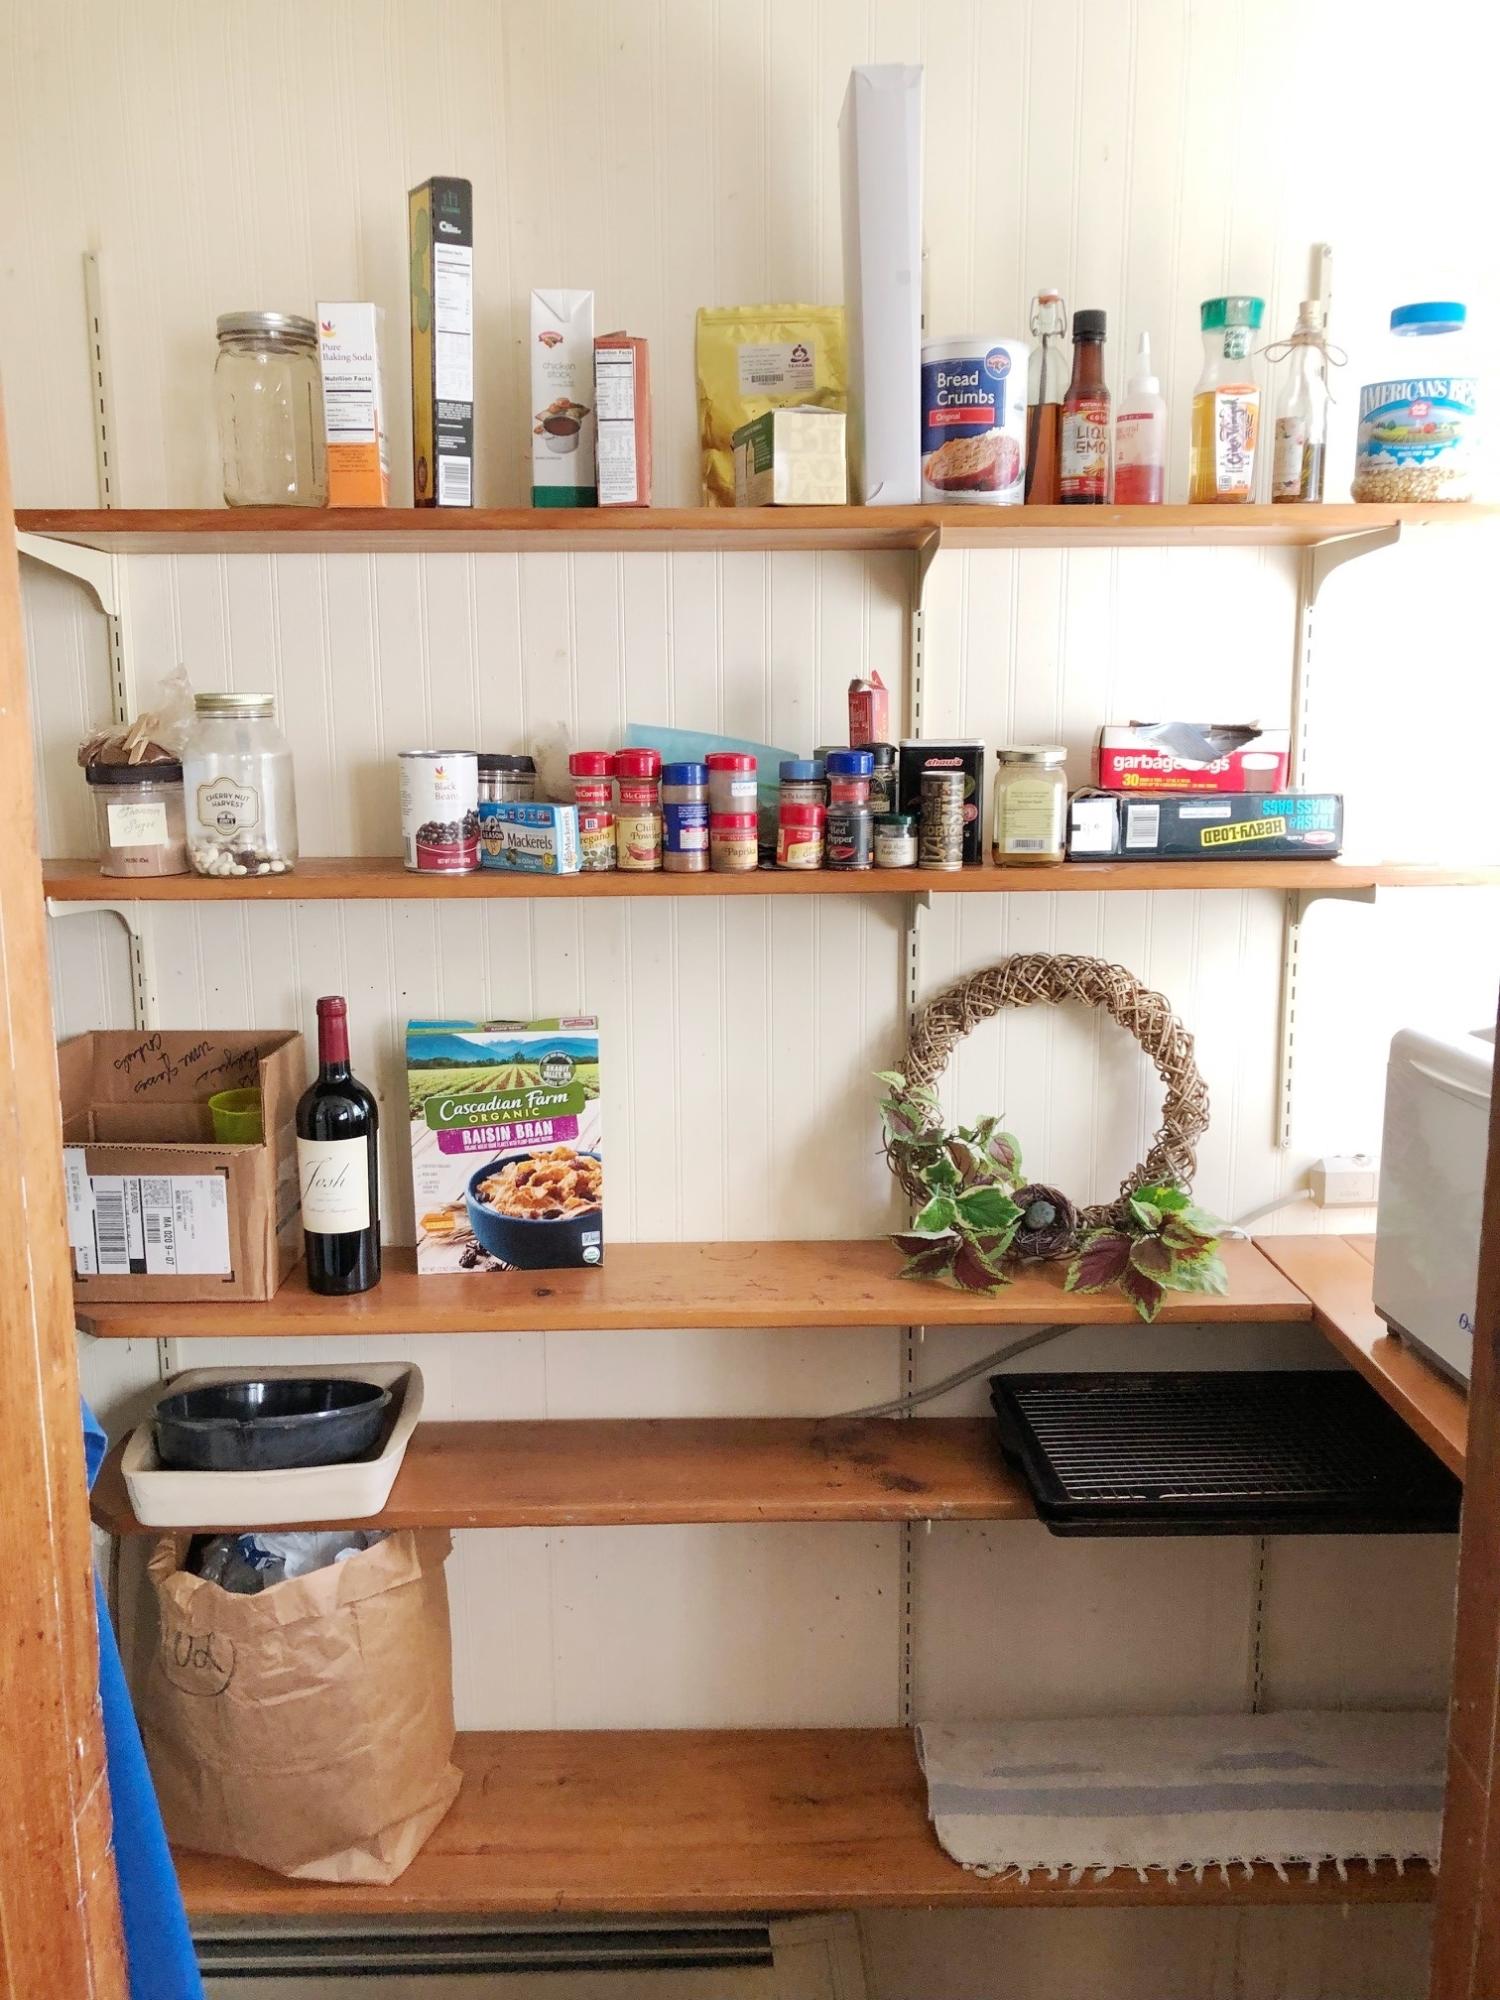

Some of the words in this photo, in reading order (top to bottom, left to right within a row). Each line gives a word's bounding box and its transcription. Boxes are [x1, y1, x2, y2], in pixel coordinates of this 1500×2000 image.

[322, 343, 343, 351] Pure
[322, 353, 351, 363] Baking
[352, 353, 372, 361] Soda
[937, 370, 979, 388] Bread
[937, 389, 995, 406] Crumbs
[935, 412, 960, 422] Original
[1113, 753, 1185, 772] garbage
[434, 782, 457, 791] Black
[1122, 773, 1139, 787] 30
[206, 792, 233, 802] CHERRY
[234, 793, 250, 802] NUT
[211, 800, 244, 808] HARVEST
[1262, 800, 1294, 816] BAGS
[830, 826, 846, 835] Red
[507, 832, 553, 850] Mackerels
[827, 835, 854, 844] Pepper
[725, 847, 757, 857] Paprika
[439, 1094, 523, 1121] Cascadian
[525, 1090, 569, 1109] Farm
[468, 1107, 541, 1123] ORGANIC
[462, 1125, 511, 1146] RAISIN
[515, 1120, 554, 1140] BRAN
[303, 1156, 350, 1200] Josh
[163, 1216, 172, 1228] MA
